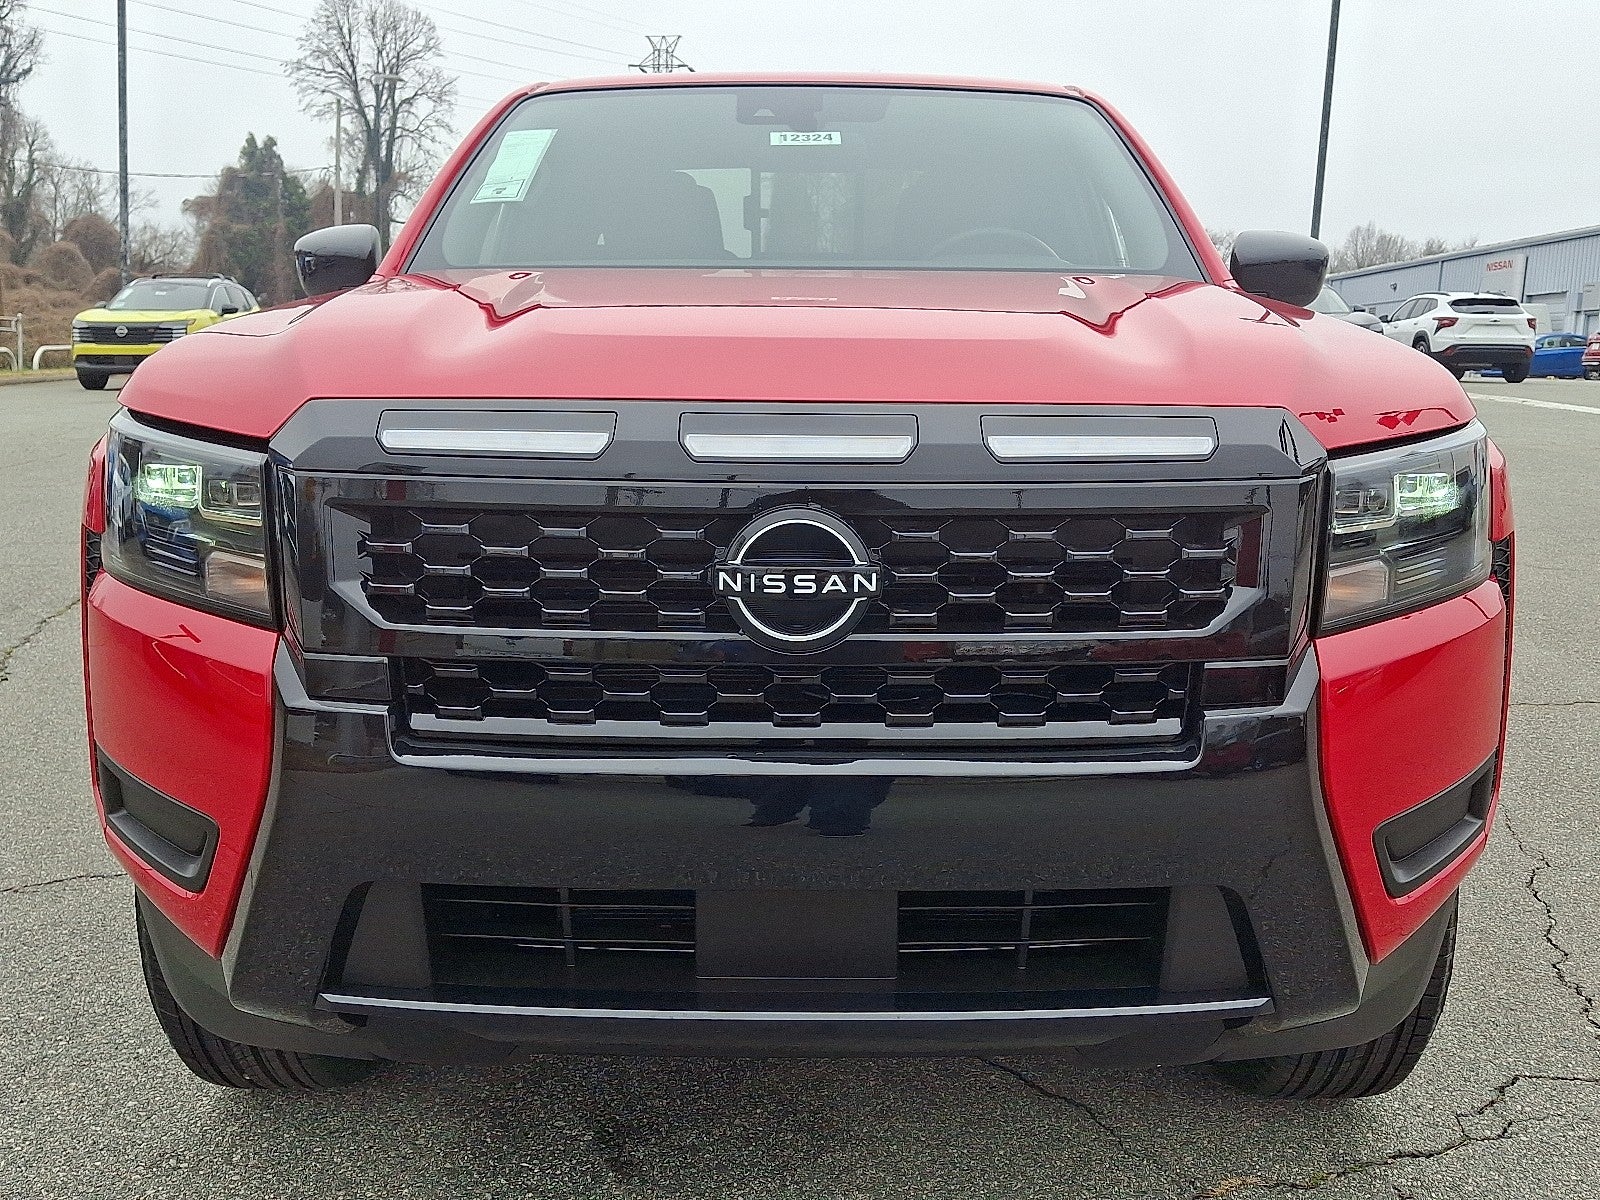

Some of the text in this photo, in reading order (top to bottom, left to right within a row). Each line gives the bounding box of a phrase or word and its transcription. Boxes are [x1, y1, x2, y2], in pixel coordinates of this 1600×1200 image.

[779, 133, 833, 142] 12324
[1486, 260, 1513, 271] NISSAN
[718, 571, 877, 594] NISSAN
